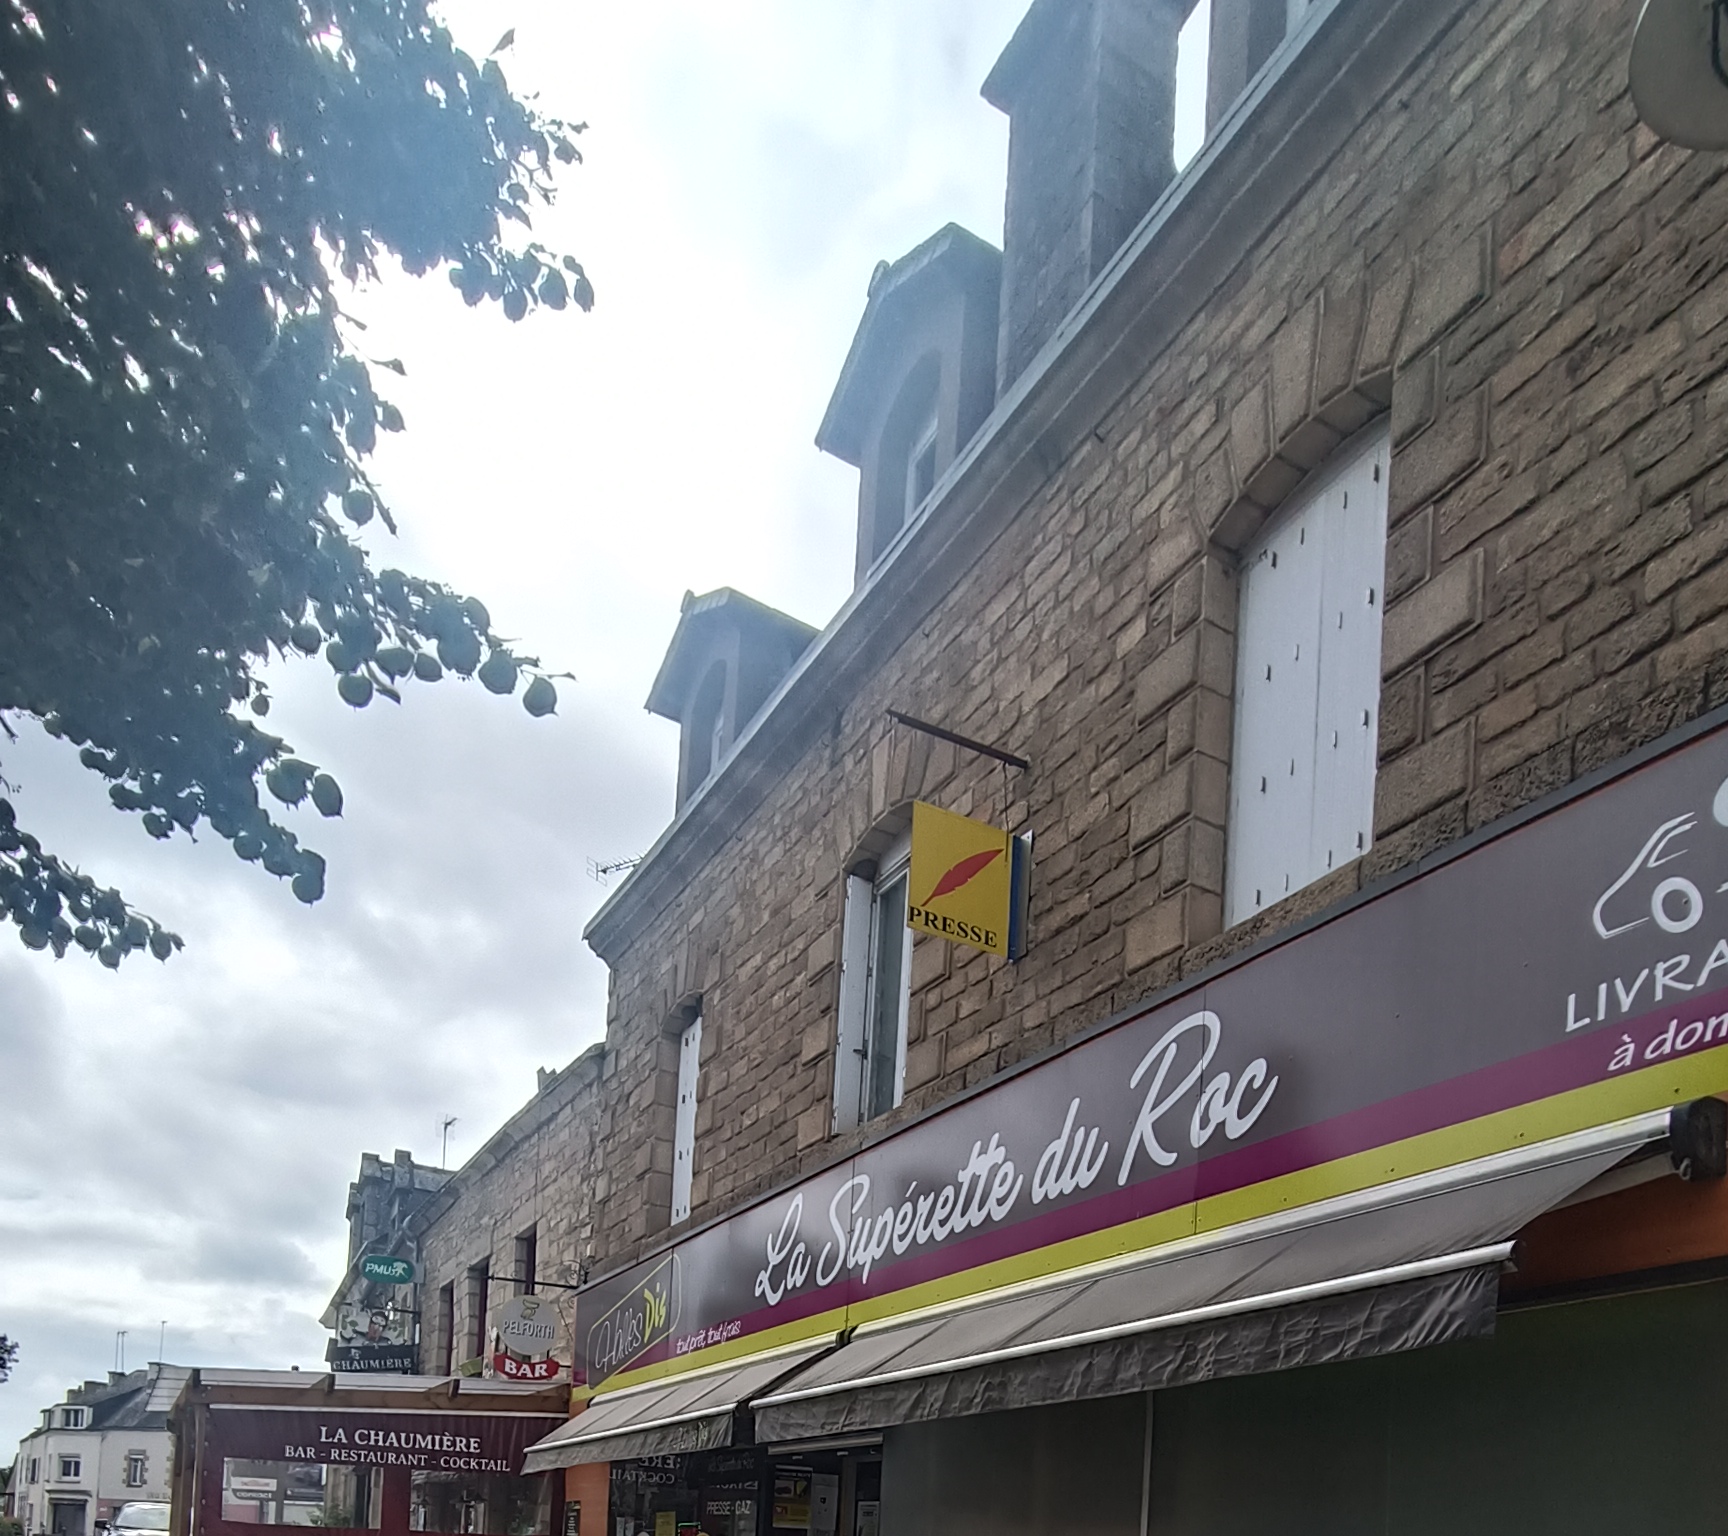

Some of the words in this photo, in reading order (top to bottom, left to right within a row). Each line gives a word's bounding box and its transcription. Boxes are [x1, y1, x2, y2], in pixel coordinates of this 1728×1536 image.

[909, 905, 998, 948] PRESSE
[1565, 938, 1728, 1033] LIVRA
[1607, 1033, 1636, 1071] à
[755, 1192, 811, 1306] La
[815, 1131, 1025, 1284] Supérette
[1031, 1097, 1109, 1205] du
[1118, 1010, 1279, 1187] Roc
[365, 1262, 392, 1275] PMU
[503, 1320, 555, 1340] PELFORTH
[595, 1308, 643, 1373] Halles
[643, 1282, 667, 1344] Dis
[707, 1323, 723, 1344] tout
[333, 1356, 412, 1370] CHAUMIÈRE
[504, 1358, 548, 1377] BAR
[319, 1426, 348, 1444] LA
[354, 1429, 481, 1453] CHAUMIÈRE
[285, 1445, 316, 1459] BAR
[330, 1449, 428, 1466] RESTAURANT
[440, 1456, 511, 1472] COCKTAIL
[735, 1500, 752, 1515] GAZ
